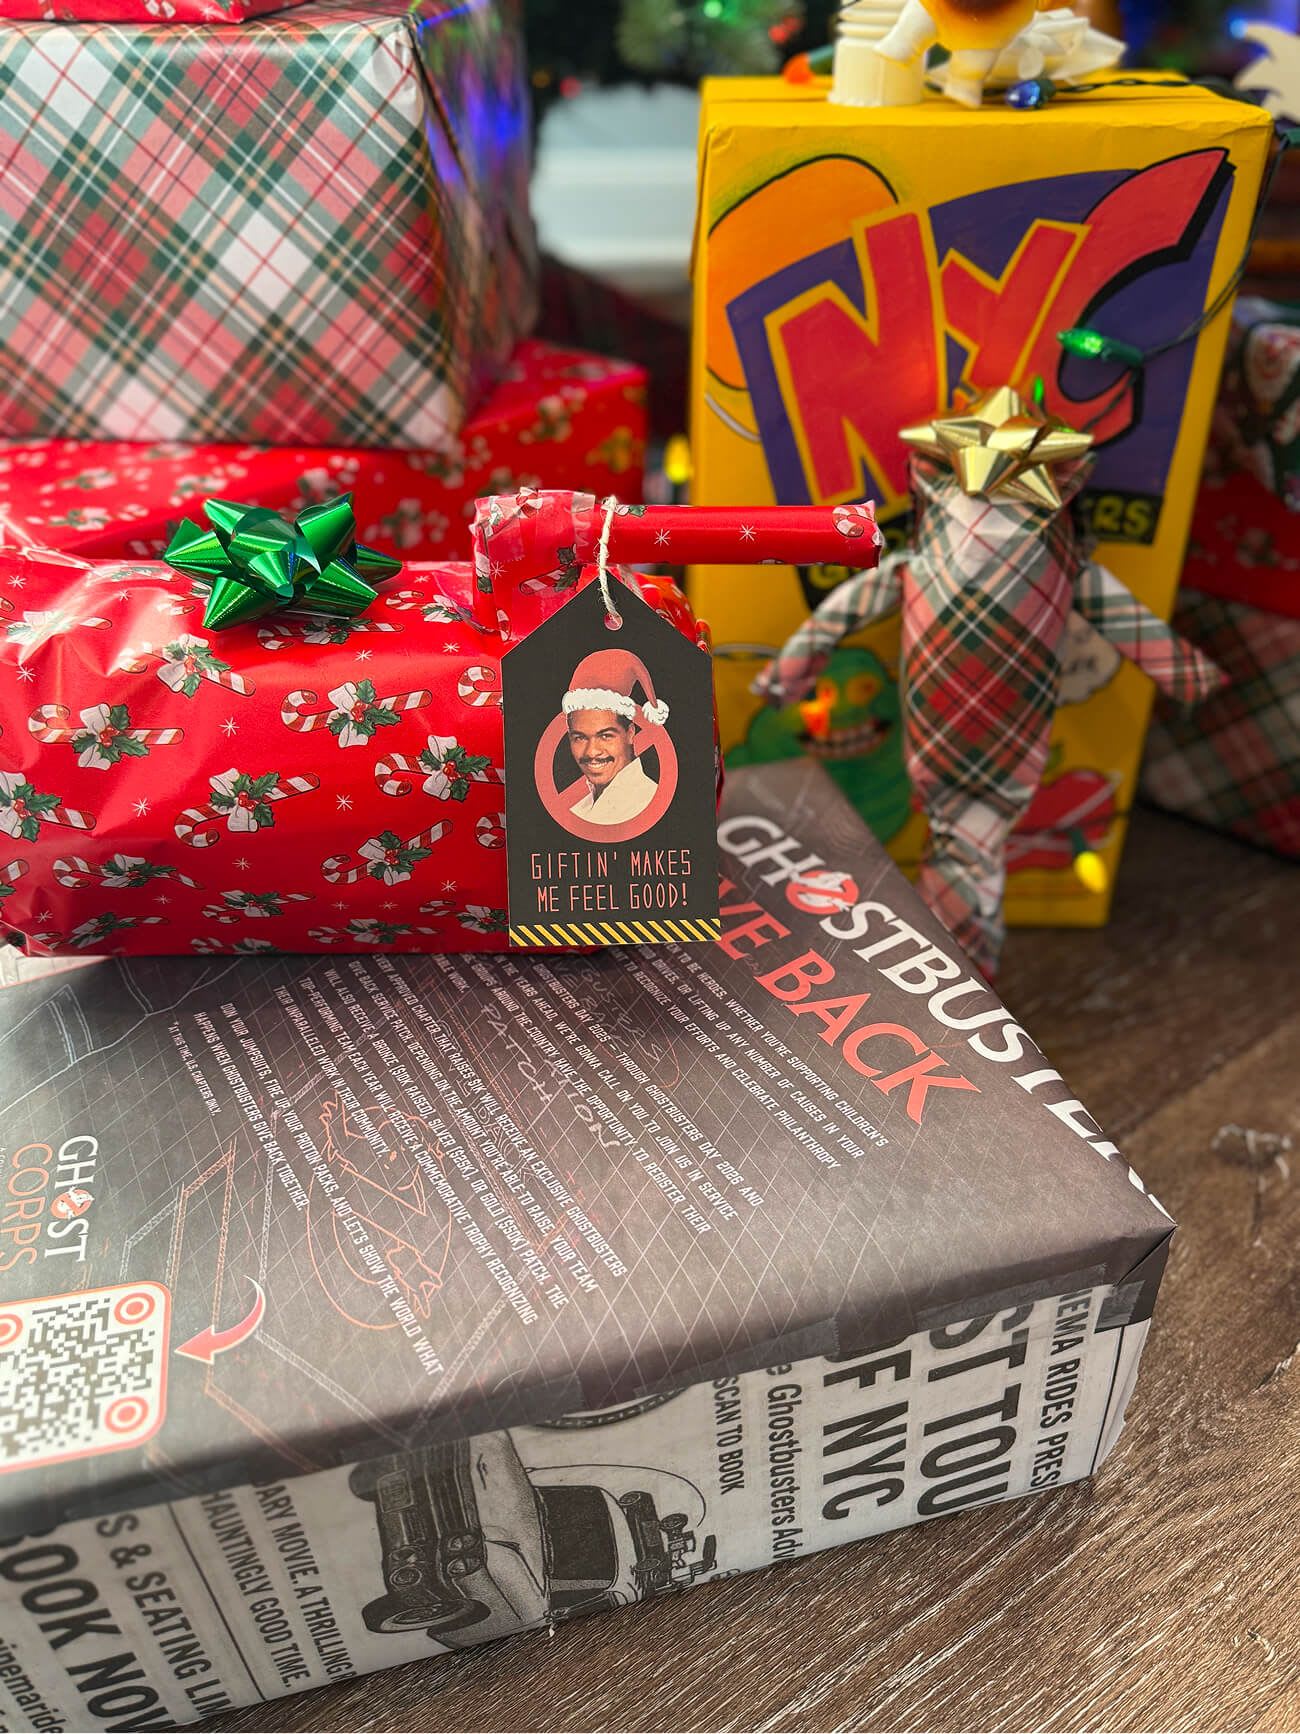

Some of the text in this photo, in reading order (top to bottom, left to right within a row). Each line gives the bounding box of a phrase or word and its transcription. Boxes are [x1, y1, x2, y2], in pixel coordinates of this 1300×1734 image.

[771, 146, 1236, 506] NYC
[531, 849, 692, 880] GIFTIN' MAKES
[537, 882, 688, 913] ME FEEL GOOD!
[191, 1068, 214, 1099] CHAPTERS
[273, 984, 390, 1158] THEIR UNPARALLELED WORK IN THEIR COMMUNITY.
[532, 963, 580, 1010] GHOSTBUSTERS
[574, 1008, 594, 1023] DAY
[588, 1023, 611, 1043] 2025
[616, 1052, 650, 1085] THROUGH
[645, 1084, 703, 1142] GHOSTBUSTERS
[698, 1141, 722, 1160] DAY
[716, 1160, 745, 1185] 2026
[738, 1186, 765, 1207] AND
[632, 970, 672, 1006] RECOGNIZE
[667, 1004, 690, 1024] YOUR
[684, 1022, 720, 1053] EFFORTS
[714, 1053, 737, 1070] AND
[731, 1068, 780, 1111] CELEBRATE
[774, 1109, 841, 1169] PHILANTHROPY
[677, 984, 865, 1159] OR LIFTING UP ANY NUMBER OF CAUSES IN YOUR
[678, 952, 692, 964] TO
[686, 962, 703, 974] BE
[725, 998, 764, 1033] WHETHER
[761, 1030, 792, 1058] YOU'RE
[787, 1056, 840, 1102] SUPPORTING
[834, 1100, 890, 1148] CHILDREN'S
[717, 872, 981, 1126] VE BACK
[717, 816, 1177, 1223] GHOSTBUSTE
[193, 1011, 310, 1212] HAPPENS WHEN GHOSTBUSTERS GIVE BACK TOGETHER.
[298, 976, 539, 1326] TOP-PERFORMING TEAM EACH YEAR WILL RECEIVE COMMEMORATIVE TROPHY RECOGNIZING
[339, 986, 570, 1310] ALSO RECEIVE BRONZE SILVER OR GOLD PATCH. THE
[360, 975, 599, 1294] BACK SERVICE DEPENDING ON THE AMOUNT YOU'RE ABLE TO RAISE, YOUR TEAM
[387, 973, 419, 1006] APPROVED
[411, 1004, 442, 1036] CHAPTER
[434, 1033, 459, 1054] THAT
[448, 1052, 476, 1080] RAISES
[479, 1092, 502, 1116] WILL
[494, 1113, 528, 1148] RECEIVE
[520, 1147, 539, 1163] AN
[531, 1160, 574, 1208] EXCLUSIVE
[566, 1206, 628, 1278] GHOSTBUSTERS
[491, 987, 520, 1012] AROUND
[514, 1011, 533, 1028] THE
[527, 1026, 560, 1058] COUNTRY
[554, 1057, 578, 1079] HAVE
[572, 1078, 592, 1094] THE
[586, 1094, 638, 1146] OPPORTUNITY
[632, 1147, 650, 1162] TO
[643, 1162, 686, 1205] REGISTER
[681, 1204, 711, 1234] THEIR
[514, 975, 538, 997] YEARS
[554, 1021, 582, 1045] WE'RE
[575, 1044, 603, 1070] GONNA
[597, 1069, 621, 1090] CALL
[616, 1089, 634, 1103] ON
[628, 1102, 650, 1120] YOU
[645, 1120, 661, 1134] TO
[655, 1136, 680, 1155] JOIN
[674, 1154, 693, 1169] US
[686, 1168, 705, 1182] IN
[698, 1182, 738, 1221] SERVICE
[0, 1143, 54, 1271] CORPS
[220, 1002, 445, 1376] DON YOUR JUMPSUITS, FIRE UP YOUR PROTON PACKS, AND LET'S SHOW THE WORLD WHAT
[712, 1375, 744, 1495] SCAN TO BOOK
[767, 1384, 802, 1526] Ghostbusters
[822, 1400, 908, 1520] NYC
[1028, 1432, 1070, 1491] PRES
[1039, 1358, 1081, 1429] RIDES
[0, 1533, 122, 1650] OOK
[109, 1543, 152, 1570] &
[125, 1571, 213, 1681] SEATING
[201, 1492, 310, 1688] HAUNTINGLY GOOD TIME.
[271, 1523, 320, 1584] MOVIE.
[293, 1585, 323, 1600] A
[300, 1597, 354, 1676] THRILLING
[0, 1638, 66, 1733] inemaride
